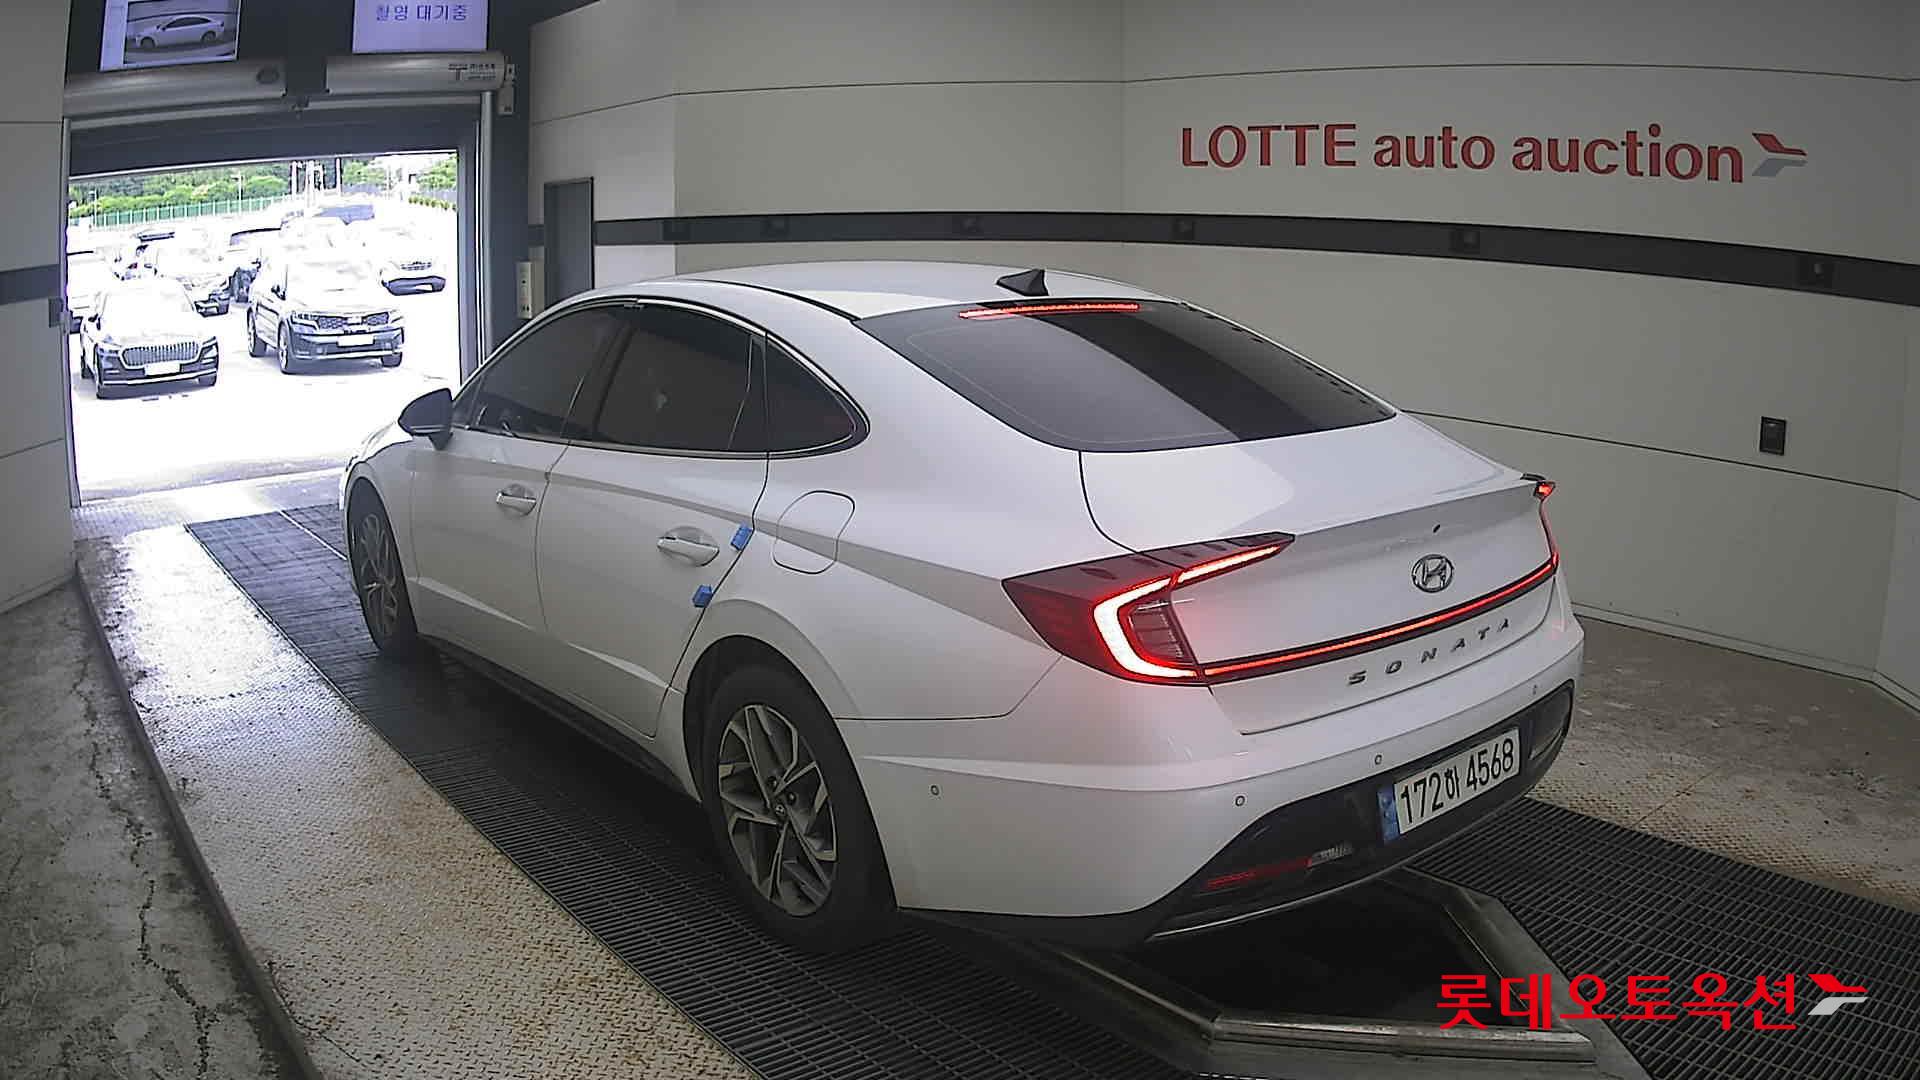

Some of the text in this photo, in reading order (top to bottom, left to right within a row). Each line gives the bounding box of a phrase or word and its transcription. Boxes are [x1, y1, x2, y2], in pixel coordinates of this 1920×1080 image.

[417, 4, 467, 23] 대기중
[1182, 123, 1744, 183] LOTTE auto auction
[1348, 618, 1510, 686] SONATA
[1400, 738, 1514, 824] 172하 4568
